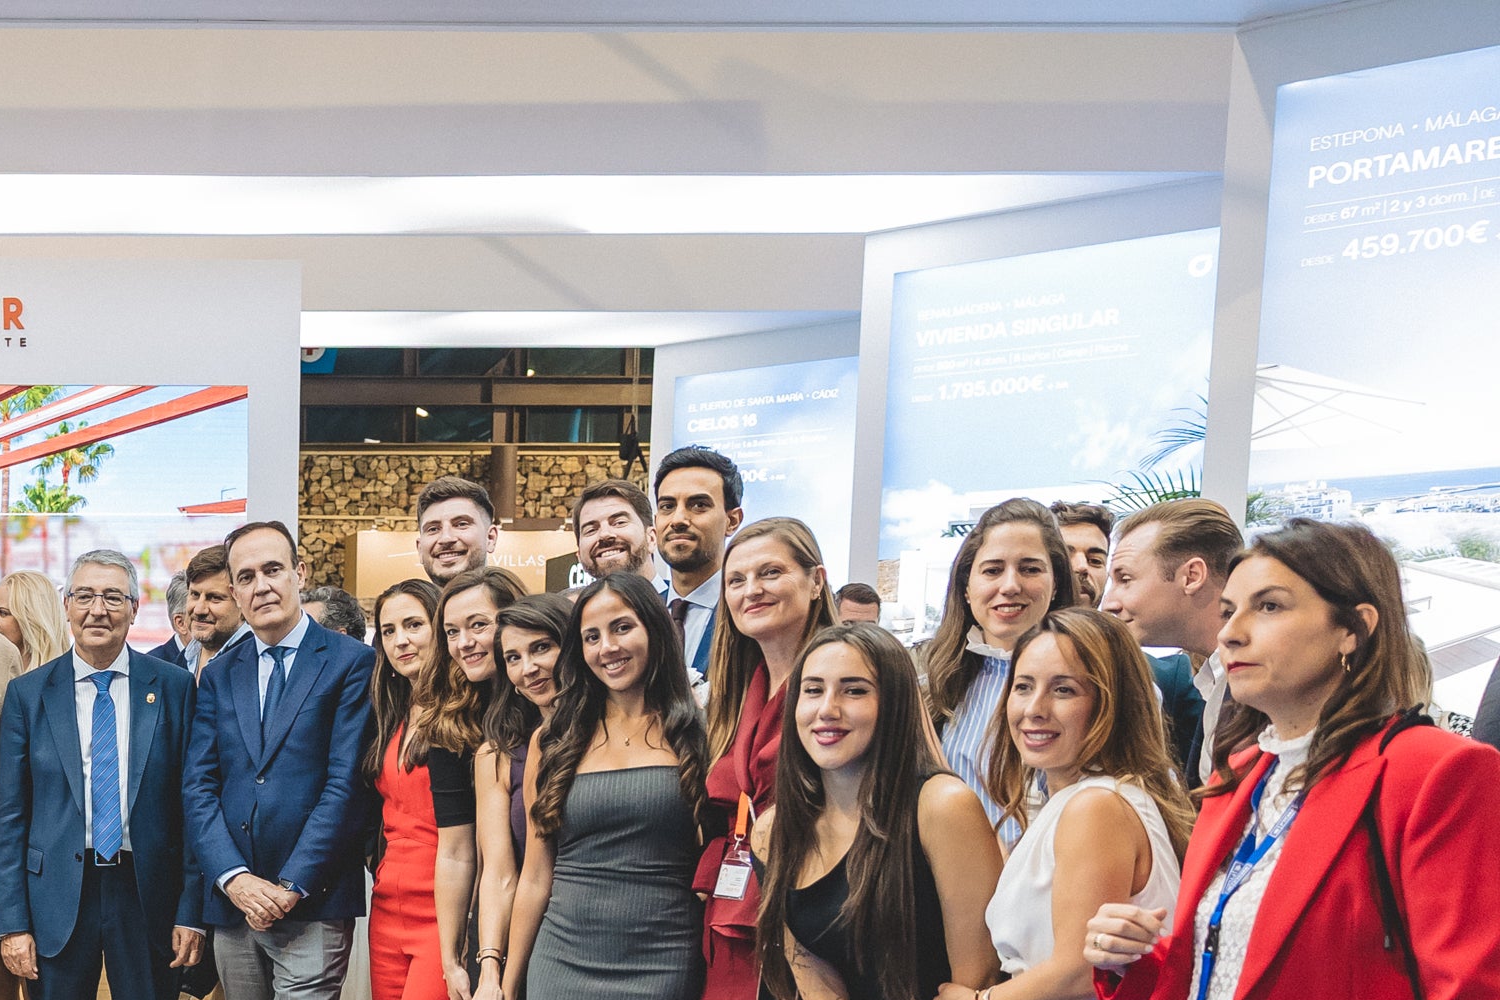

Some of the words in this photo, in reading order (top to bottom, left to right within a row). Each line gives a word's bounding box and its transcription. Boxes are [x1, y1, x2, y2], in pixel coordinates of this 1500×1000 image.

[1309, 123, 1405, 152] ESTEPONA
[1308, 136, 1500, 189] PORTAMARE
[1340, 205, 1360, 220] 67
[1390, 200, 1400, 213] 2
[1402, 199, 1413, 213] y
[1415, 196, 1426, 209] 3
[1342, 219, 1491, 261] 459.700€
[916, 321, 1007, 348] VIVIENDA
[1011, 308, 1120, 337] SINGULAR
[733, 399, 746, 408] DE
[747, 395, 775, 406] SANTA
[811, 388, 839, 400] CÁDIZ
[938, 374, 1046, 401] 1.795.000€
[687, 415, 740, 432] CIELOS
